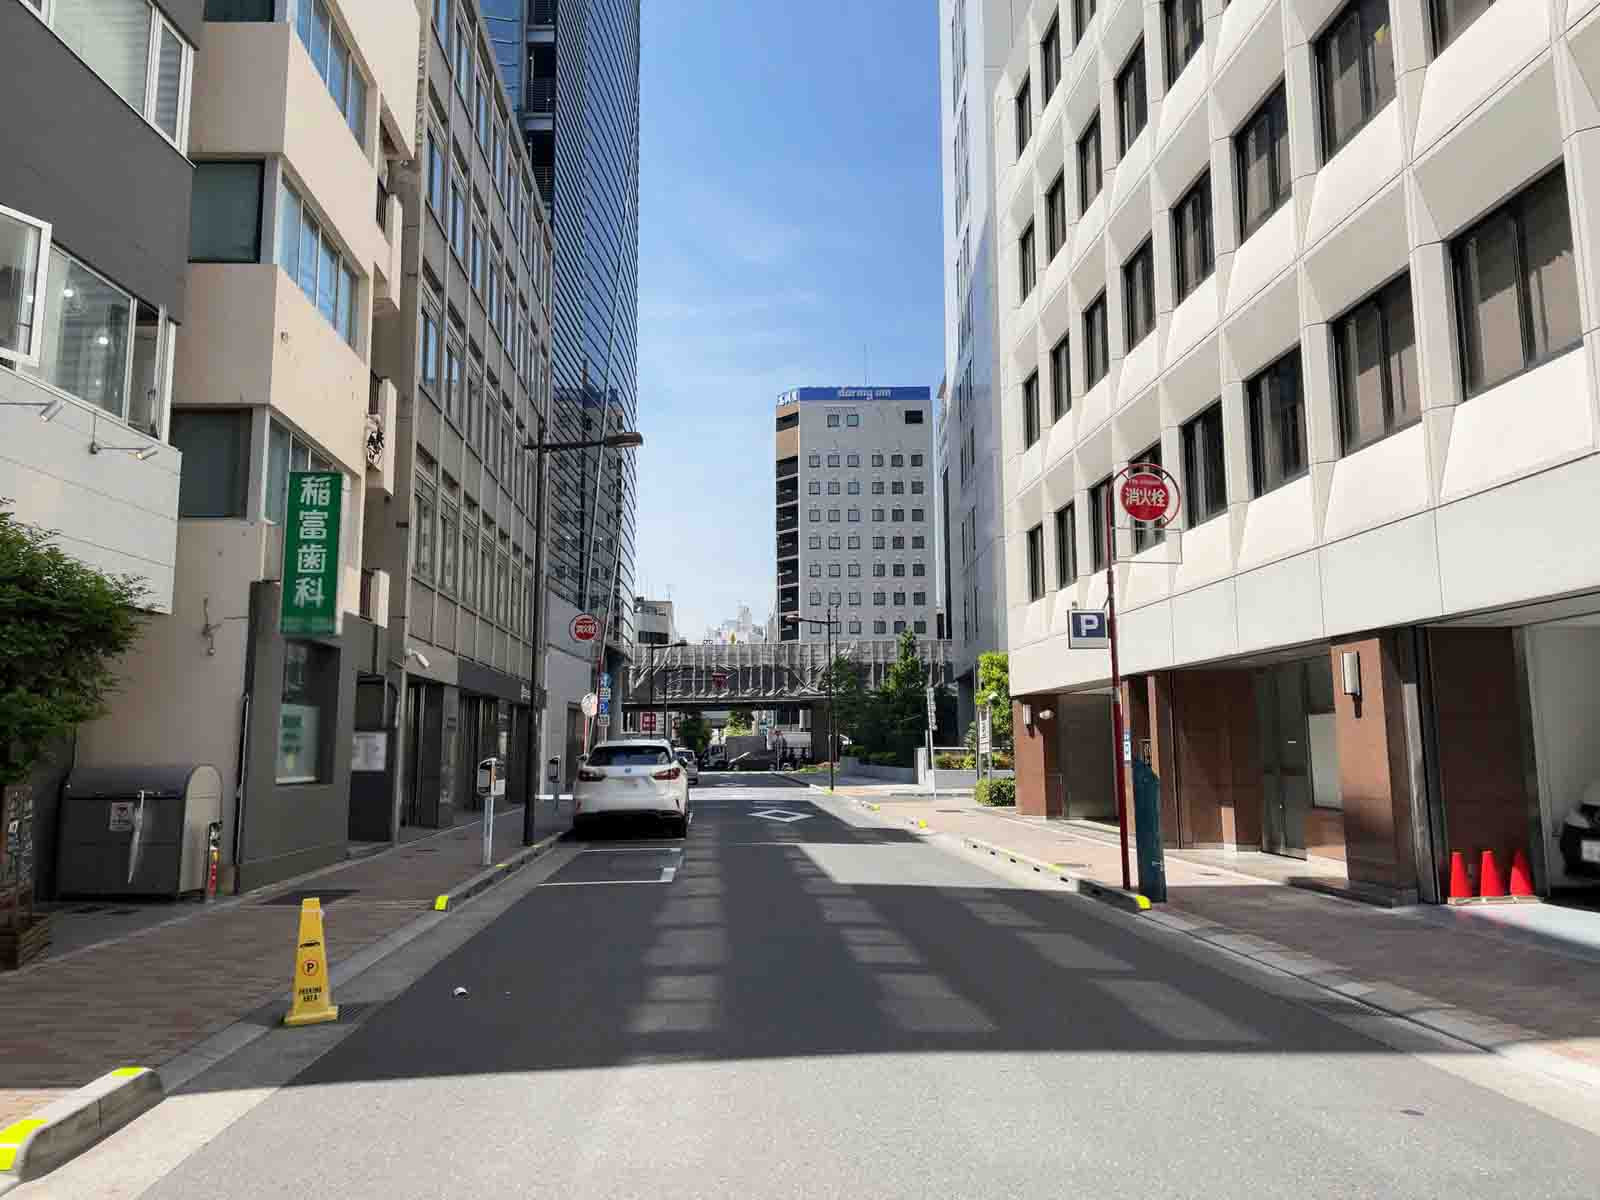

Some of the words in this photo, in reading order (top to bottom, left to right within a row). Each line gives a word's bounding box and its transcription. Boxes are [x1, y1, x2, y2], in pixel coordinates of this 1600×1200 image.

[1125, 487, 1166, 507] 消火栓
[1080, 614, 1099, 637] P
